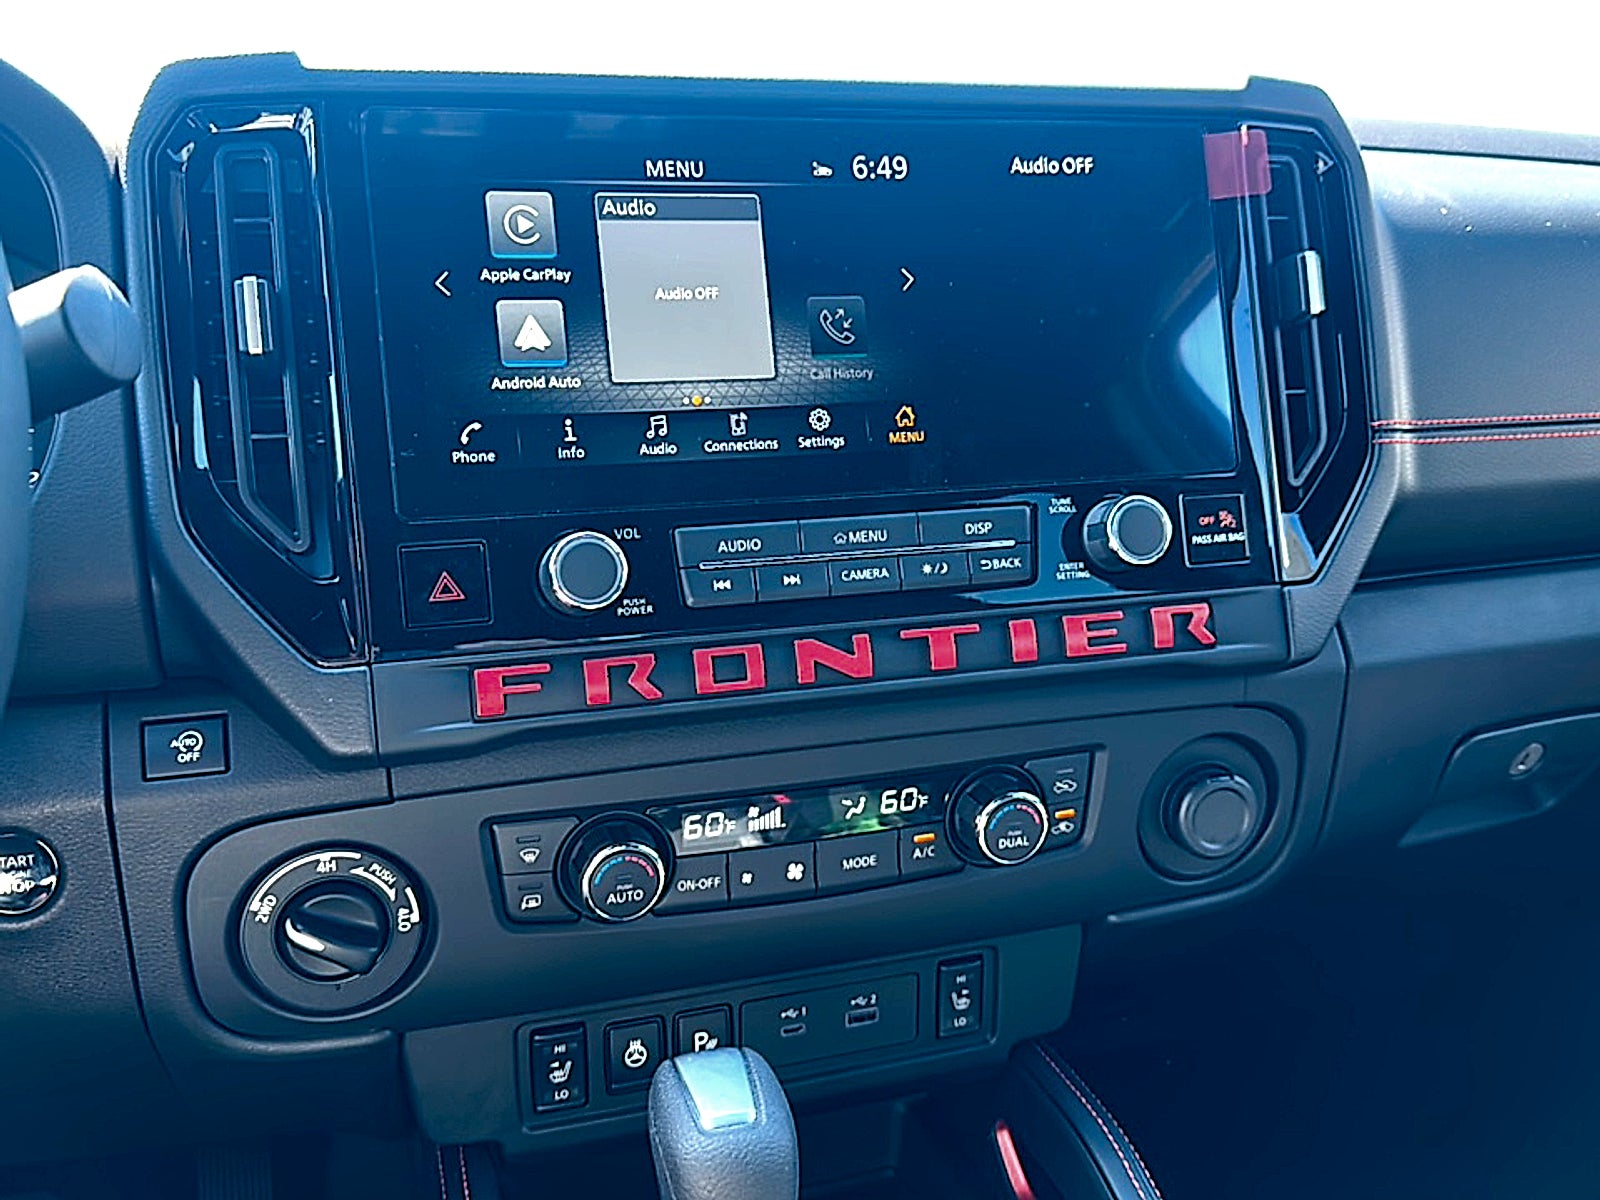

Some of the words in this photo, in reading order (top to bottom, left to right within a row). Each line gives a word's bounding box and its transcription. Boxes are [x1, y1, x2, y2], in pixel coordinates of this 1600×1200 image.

[645, 159, 705, 178] MENU
[851, 155, 908, 180] 6:49
[1010, 155, 1060, 174] Audio
[1061, 156, 1094, 174] OFF
[602, 199, 657, 217] Audio
[479, 268, 521, 284] Apple
[522, 268, 572, 284] CarPlay
[655, 287, 694, 301] Audio
[694, 287, 719, 300] OFF
[810, 368, 833, 380] Call
[834, 368, 874, 381] History
[491, 376, 546, 390] Android
[549, 376, 582, 389] Auto
[798, 434, 846, 450] Settings
[889, 431, 925, 444] MENU
[557, 446, 585, 459] Info
[640, 442, 678, 455] Audio
[704, 438, 779, 453] Connections
[452, 451, 496, 463] Phone
[965, 521, 993, 536] DISP
[1199, 516, 1215, 526] OFF
[613, 528, 642, 539] VOL
[849, 529, 888, 544] MENU
[1191, 534, 1212, 545] PASS
[718, 538, 762, 553] AUDIO
[993, 557, 1022, 570] BACK
[841, 567, 890, 582] CAMERA
[616, 605, 655, 617] POWER
[473, 602, 1217, 717] FRONTIER
[170, 737, 198, 748] AUTO
[177, 751, 201, 763] OFF
[998, 835, 1030, 850] DUAL
[913, 845, 936, 860] A/C
[0, 854, 35, 869] TART
[316, 860, 337, 874] 4H
[842, 855, 878, 870] MODE
[368, 862, 397, 886] PUSH
[676, 876, 722, 892] ON-OFF
[606, 888, 645, 905] AUTO
[254, 894, 278, 924] 2WD
[956, 975, 966, 985] HI
[953, 1017, 967, 1028] LO
[553, 1043, 567, 1055] HI
[554, 1089, 570, 1101] LO
